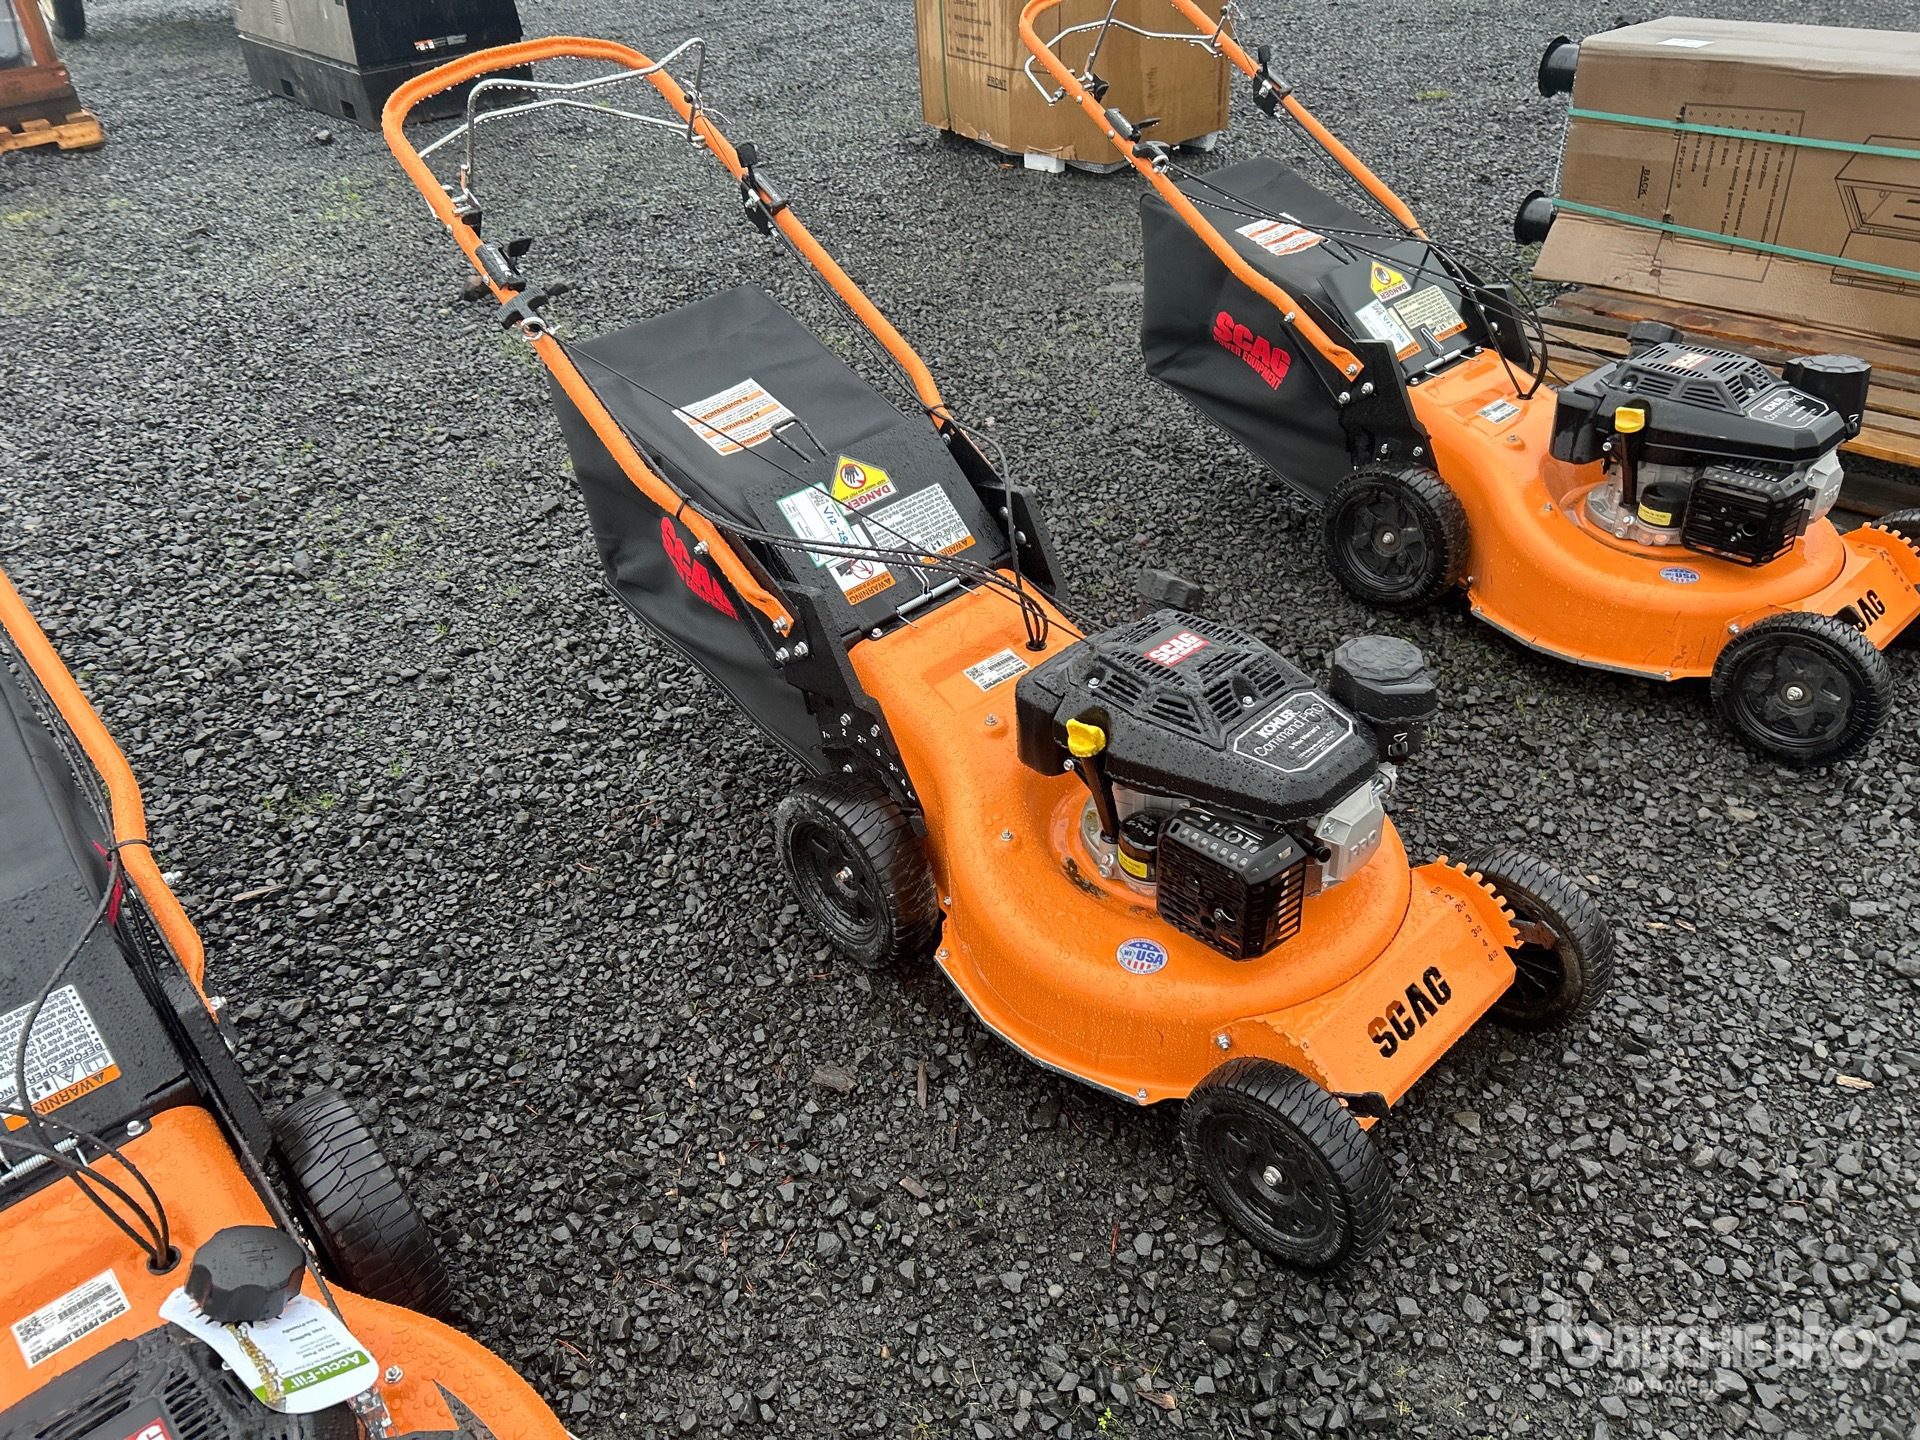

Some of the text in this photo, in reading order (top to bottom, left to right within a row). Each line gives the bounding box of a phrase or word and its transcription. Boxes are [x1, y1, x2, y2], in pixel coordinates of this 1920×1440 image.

[988, 76, 1006, 88] FRONT
[1690, 150, 1699, 172] handle
[1704, 140, 1716, 173] electronic
[1720, 147, 1729, 165] Black
[1641, 170, 1650, 196] BACK
[1770, 174, 1780, 197] carbon
[1733, 197, 1746, 230] adjustable
[1379, 283, 1407, 299] DANGER
[1214, 311, 1291, 378] SCAG
[1242, 350, 1282, 391] EQUIPMENT
[700, 398, 743, 420] ADVERTENCIA
[720, 415, 754, 431] ATTENTION
[661, 517, 736, 613] SCAG
[848, 580, 886, 604] WARNING
[1148, 632, 1199, 660] SCAG
[1254, 720, 1305, 756] Command
[1301, 704, 1324, 722] PRO
[1256, 709, 1298, 738] KOHLER
[1347, 828, 1378, 862] PRO
[1465, 914, 1471, 922] 3
[1136, 949, 1163, 965] USA
[58, 996, 71, 1007] Use
[1368, 966, 1452, 1058] SCAG
[3, 1014, 14, 1024] en
[7, 1003, 74, 1040] Mow across of
[30, 1010, 78, 1037] Do not operate
[62, 1017, 82, 1031] Look
[37, 1024, 86, 1052] Clear area of
[41, 1026, 63, 1041] down
[59, 1038, 74, 1050] sure
[72, 1031, 90, 1044] Make
[38, 1038, 93, 1068] Read operator's
[39, 1044, 61, 1059] guards
[58, 1042, 103, 1069] BEFORE
[34, 1080, 94, 1114] WARNIN
[29, 1301, 126, 1364] SCAG POWER EQUIPMENT
